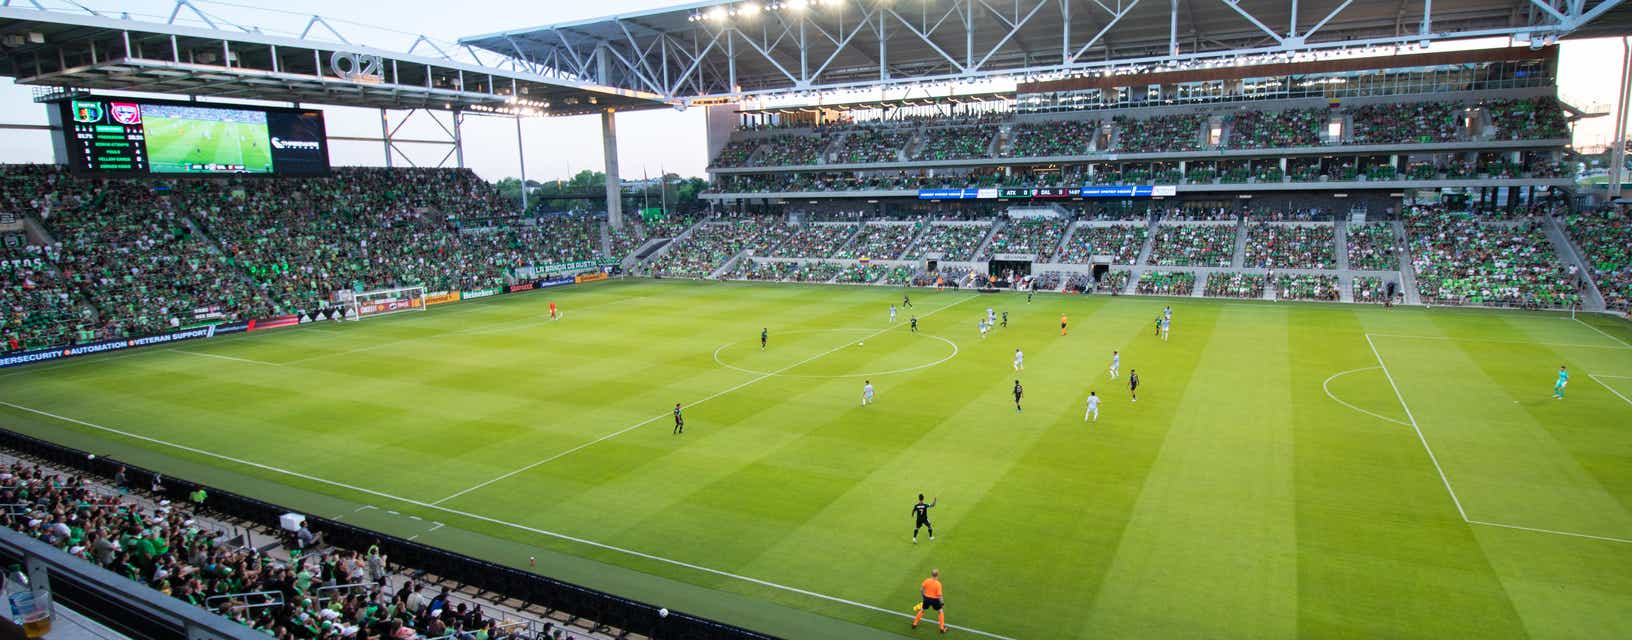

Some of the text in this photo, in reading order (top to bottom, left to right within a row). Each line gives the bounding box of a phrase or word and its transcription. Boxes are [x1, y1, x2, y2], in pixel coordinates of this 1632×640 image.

[463, 288, 493, 300] Heineken
[71, 341, 128, 355] AUTOMATION
[134, 334, 171, 345] VETERAN
[172, 329, 208, 340] SUPPORT
